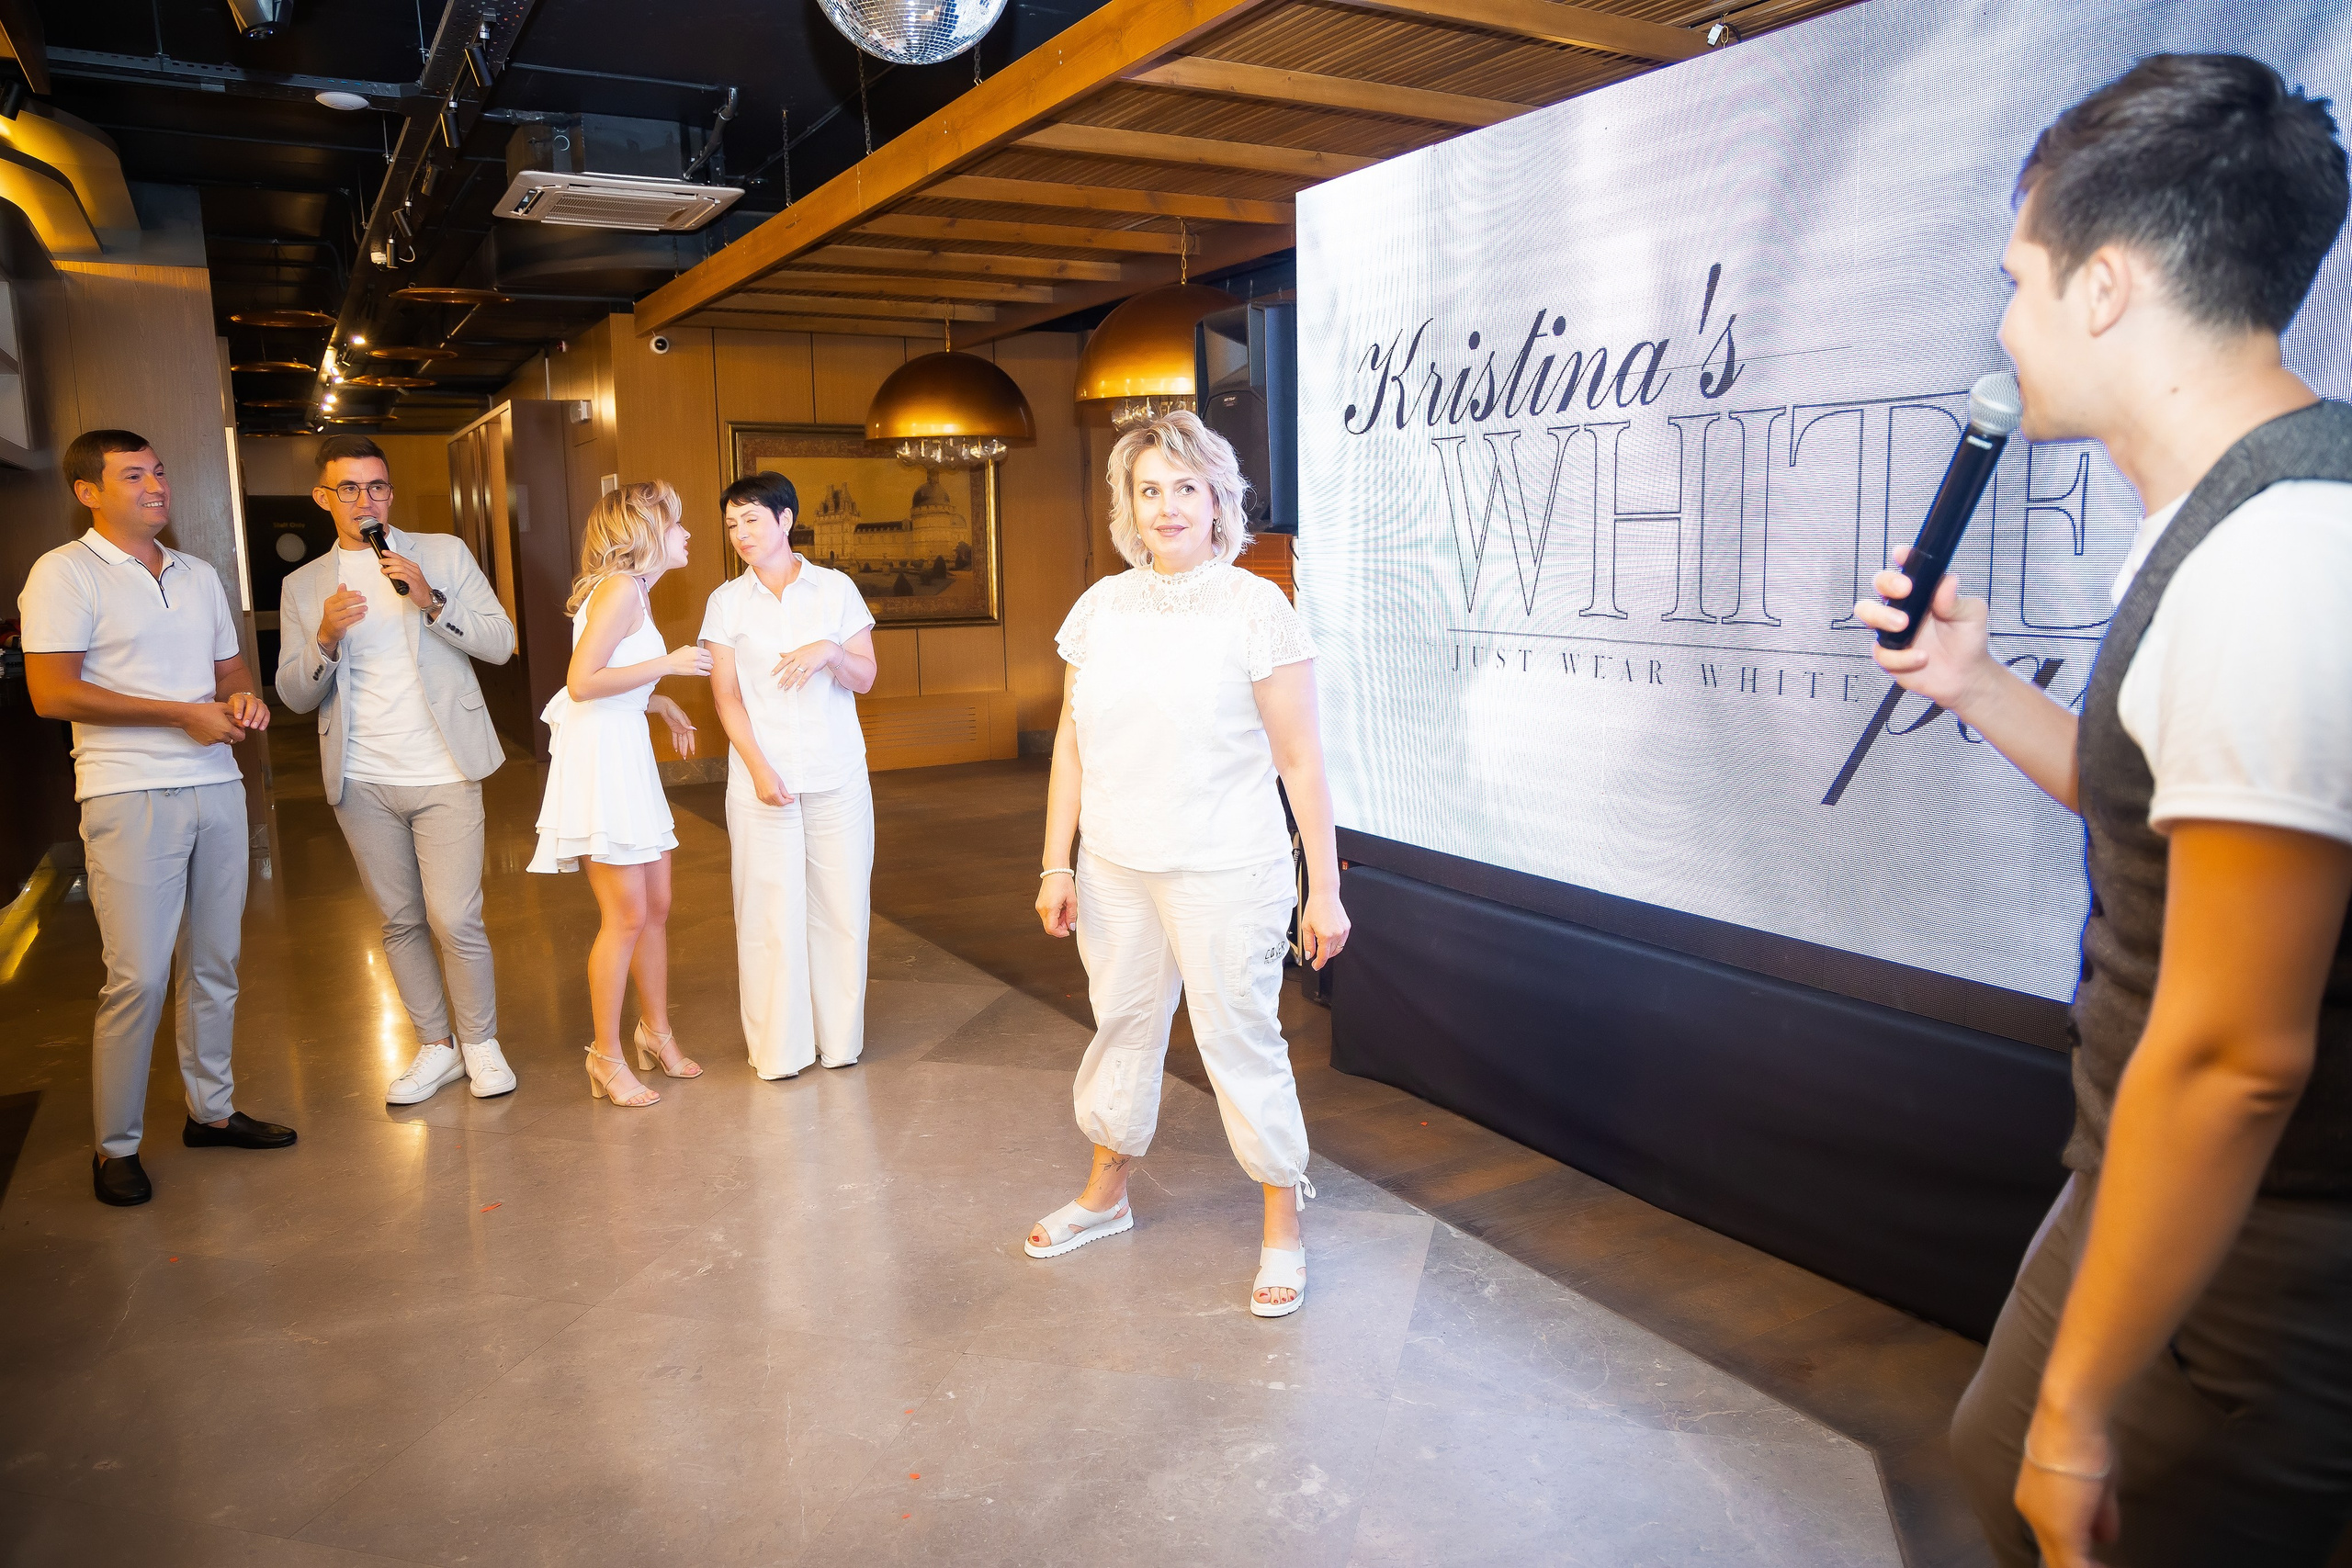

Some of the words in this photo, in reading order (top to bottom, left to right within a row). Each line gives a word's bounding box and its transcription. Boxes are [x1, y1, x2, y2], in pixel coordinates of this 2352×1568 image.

[1345, 263, 1746, 435] Kristina's
[1430, 389, 2111, 632] WHITE
[1452, 644, 1532, 672] JUST
[1562, 651, 1664, 685] WEAR
[1701, 662, 1860, 702] WHITE
